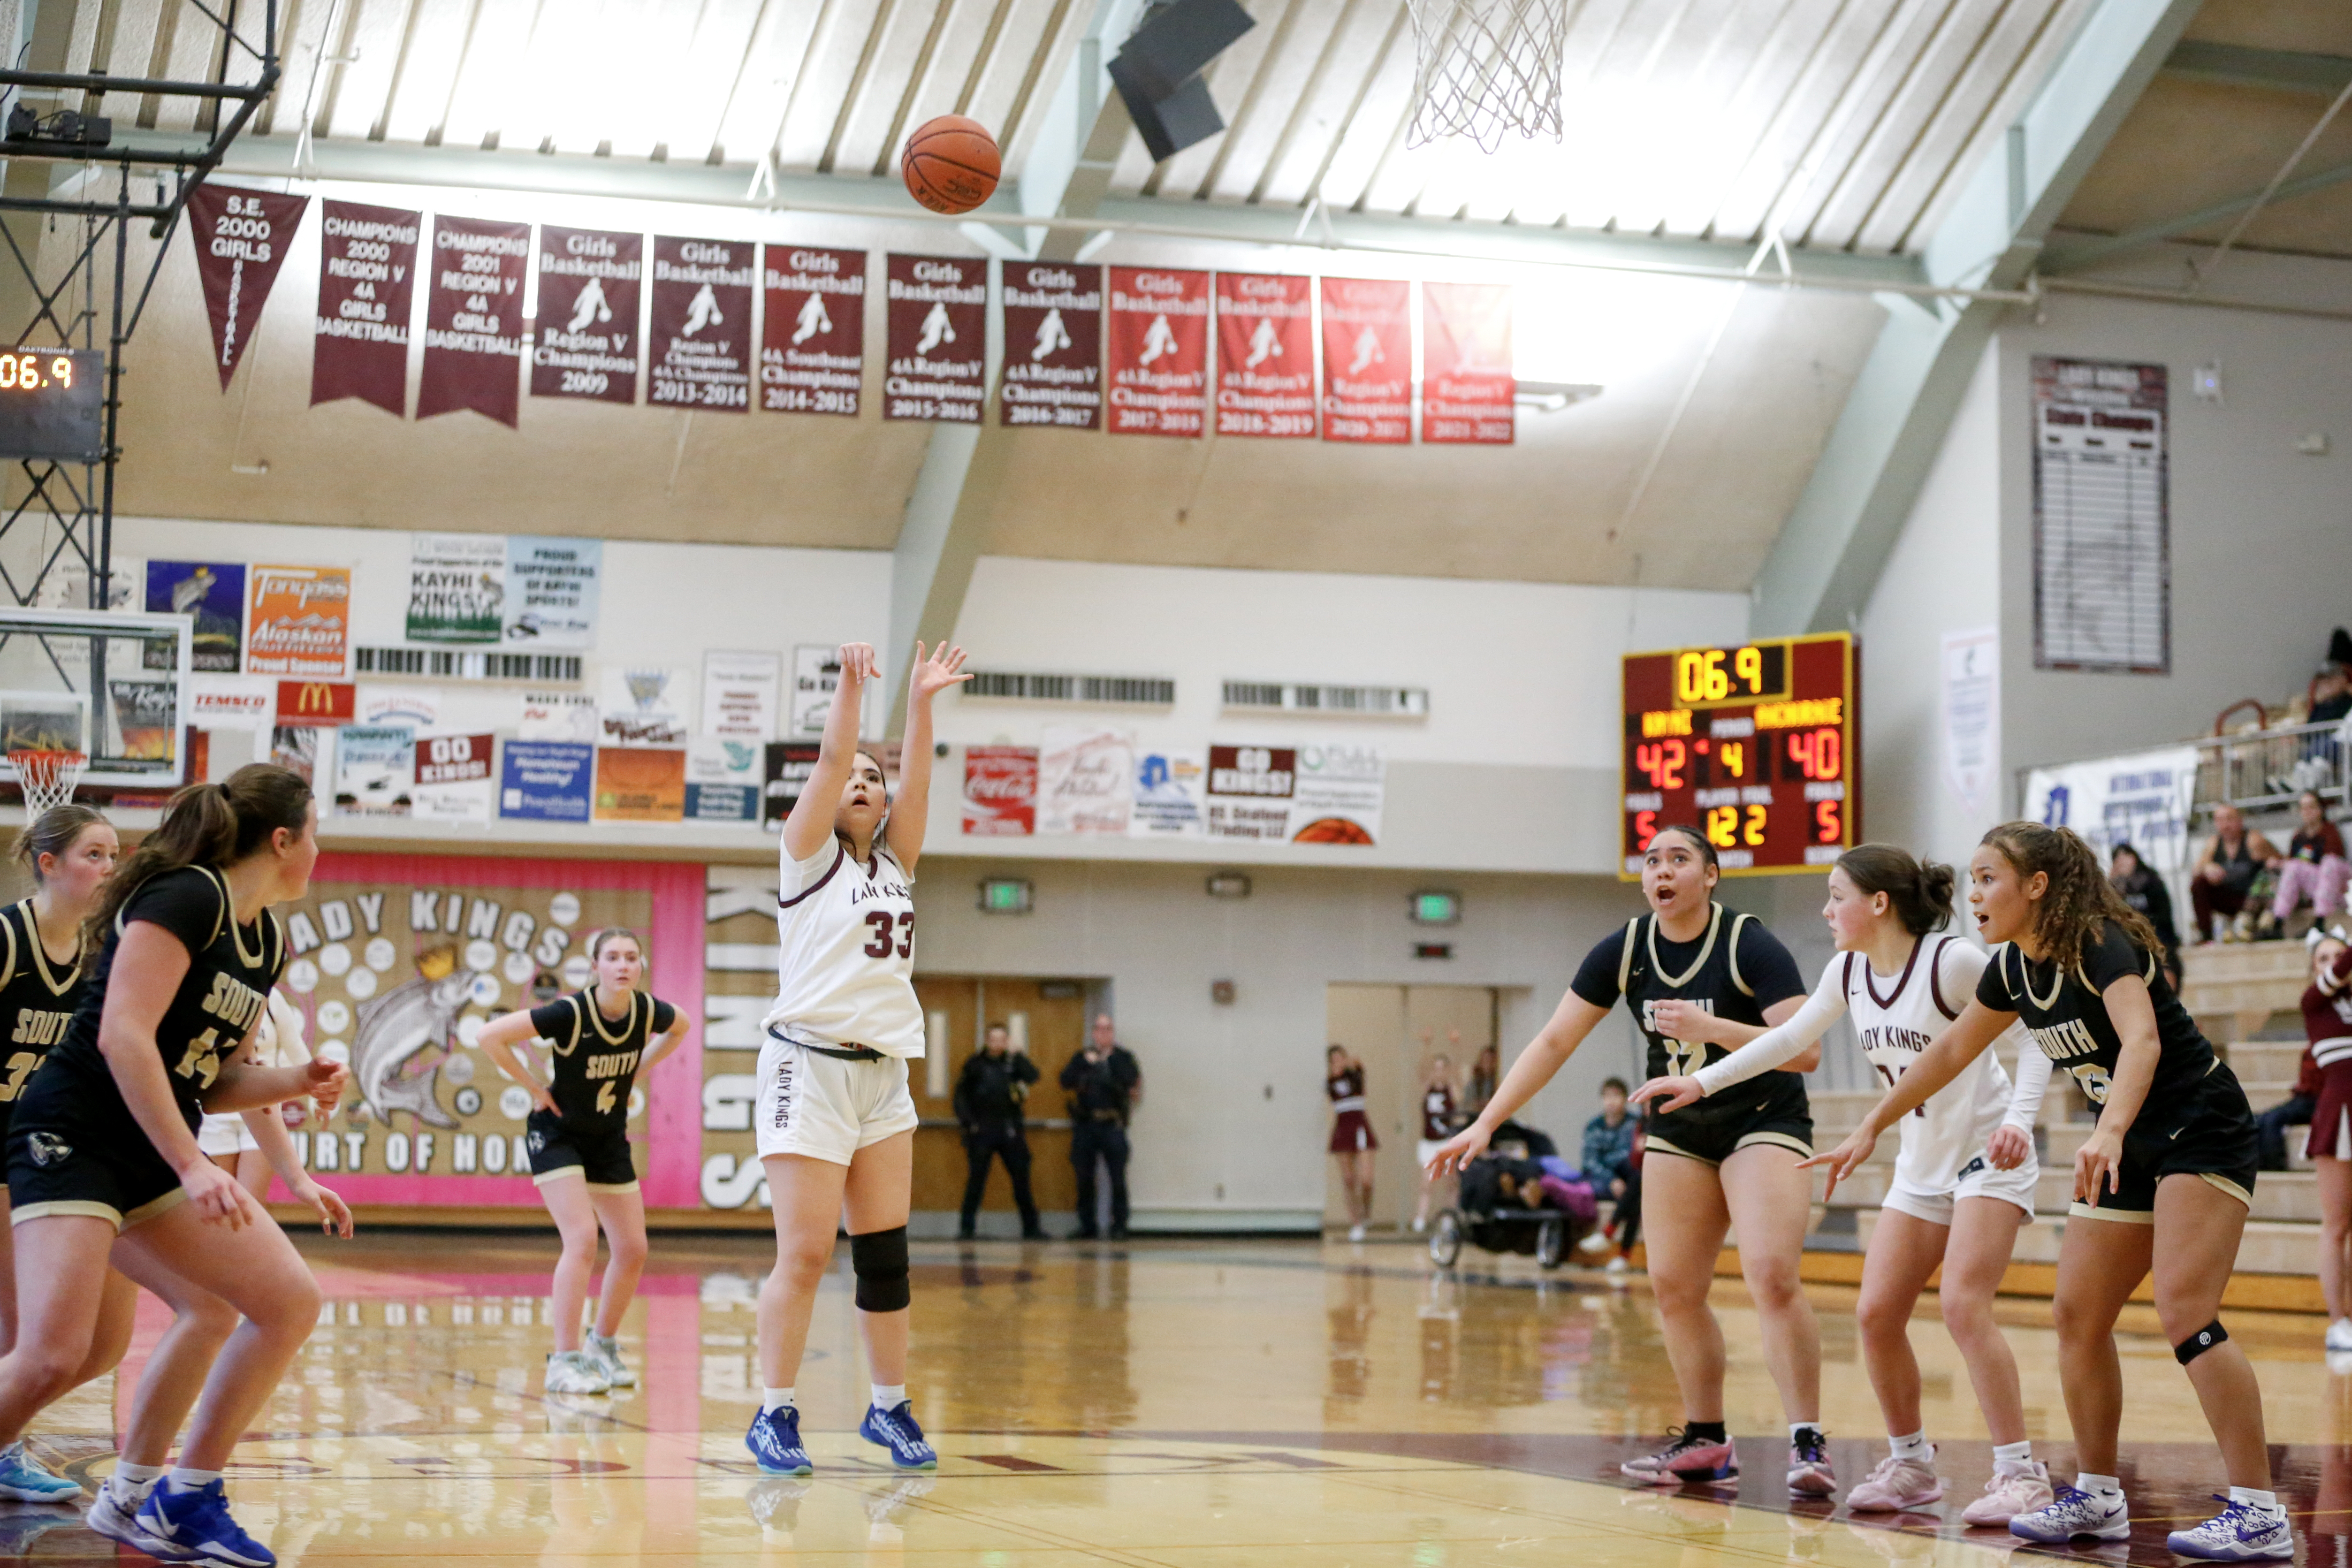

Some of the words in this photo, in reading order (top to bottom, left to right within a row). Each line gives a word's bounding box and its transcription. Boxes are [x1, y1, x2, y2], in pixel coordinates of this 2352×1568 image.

[227, 196, 264, 217] S.E.
[217, 216, 271, 240] 2000
[325, 217, 417, 245] CHAMPIONS
[212, 238, 271, 262] GIRLS
[347, 240, 389, 261] 2000
[437, 230, 528, 257] CHAMPIONS
[567, 235, 617, 259] Girls
[681, 242, 731, 265] Girls
[328, 258, 389, 282] REGION
[393, 265, 405, 282] V
[462, 254, 501, 274] 2001
[540, 253, 640, 280] Basketball
[657, 260, 753, 286] Basketball
[790, 251, 840, 273] Girls
[913, 262, 962, 283] Girls
[353, 281, 375, 300] 4A
[441, 270, 501, 293] REGION
[504, 278, 517, 295] V
[766, 269, 863, 296] Basketball
[1028, 268, 1077, 289] Girls
[1135, 274, 1183, 295] Girls
[1241, 277, 1287, 297] Girls
[465, 294, 488, 313] 4A
[889, 280, 985, 304] Basketball
[1005, 286, 1100, 311] Basketball
[1112, 292, 1209, 316] Basketball
[340, 299, 386, 322] GIRLS
[1218, 296, 1311, 318] Basketball
[317, 316, 408, 344] BASKETBALL
[453, 312, 499, 334] GIRLS
[427, 328, 520, 356] BASKETBALL
[544, 327, 609, 353] Region
[613, 333, 629, 352] V
[670, 338, 716, 355] Region
[717, 341, 731, 355] V
[534, 347, 637, 374] Champions
[665, 351, 739, 371] Champions
[762, 349, 784, 365] 4A
[892, 358, 913, 375] 4A
[914, 357, 968, 378] Region
[968, 361, 983, 377] V
[562, 371, 609, 395] 2009
[671, 366, 749, 385] Champions
[761, 365, 861, 389] Champions
[1006, 365, 1028, 383] 4A
[1029, 365, 1082, 386] Region
[1082, 366, 1097, 385] V
[1140, 370, 1191, 389] Region
[654, 379, 748, 405] 2013-2014
[765, 388, 857, 414] 2014-2015
[886, 378, 984, 400] Champions
[1003, 385, 1100, 407] Champions
[1111, 388, 1207, 411] Champions
[1218, 390, 1312, 412] Champions
[891, 400, 978, 420] 2015-2016
[534, 548, 577, 561] PROUD
[412, 571, 472, 588] KAYHI
[411, 591, 484, 610] KINGS!
[251, 617, 342, 645] Alaskan
[250, 655, 287, 671] Proud
[290, 657, 343, 674] Sponsor
[1678, 647, 1762, 701] 06.9
[196, 694, 266, 708] TEMSCO
[1236, 748, 1271, 770] GO
[1637, 739, 1686, 789] 42
[1720, 742, 1743, 777] 4
[1789, 728, 1840, 780] 40
[1212, 768, 1291, 794] KINGS!
[1636, 811, 1658, 851] 5
[1744, 804, 1767, 845] 2
[1817, 799, 1840, 842] 5
[287, 892, 384, 955] ADY
[411, 891, 569, 967] KINGS
[865, 911, 914, 959] 33
[201, 971, 266, 1031] SOUT
[12, 1008, 73, 1045] SOUT
[701, 866, 780, 1209] KINGS
[777, 1061, 793, 1092] LADY
[775, 1095, 791, 1129] KINGS
[290, 1131, 366, 1171] URT
[385, 1132, 434, 1172] OF
[453, 1133, 533, 1174] HON
